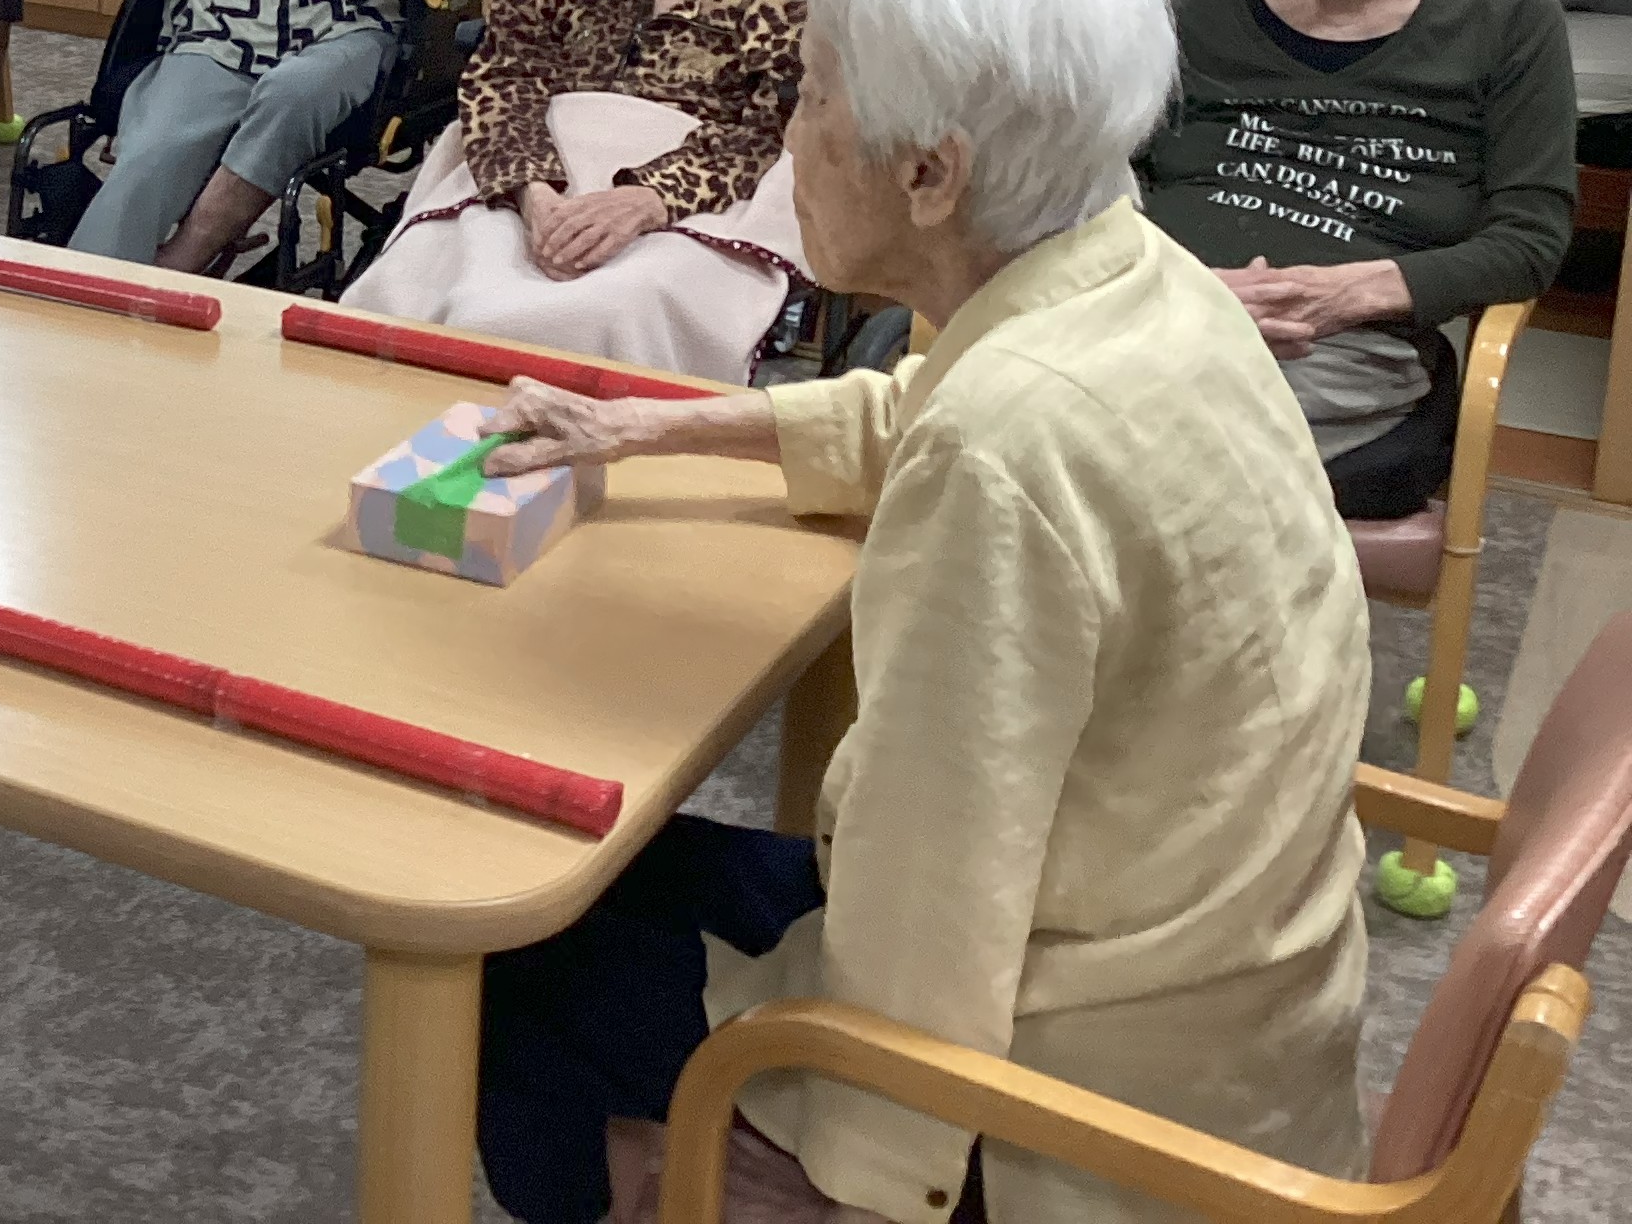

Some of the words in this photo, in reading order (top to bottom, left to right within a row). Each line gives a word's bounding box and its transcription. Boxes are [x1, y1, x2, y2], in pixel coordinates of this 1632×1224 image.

[1226, 127, 1283, 157] LIFE
[1216, 161, 1273, 183] CAN
[1276, 164, 1317, 189] DO
[1322, 178, 1339, 196] A
[1348, 183, 1405, 216] LOT
[1207, 189, 1263, 211] AND
[1268, 201, 1356, 243] WIDTH
